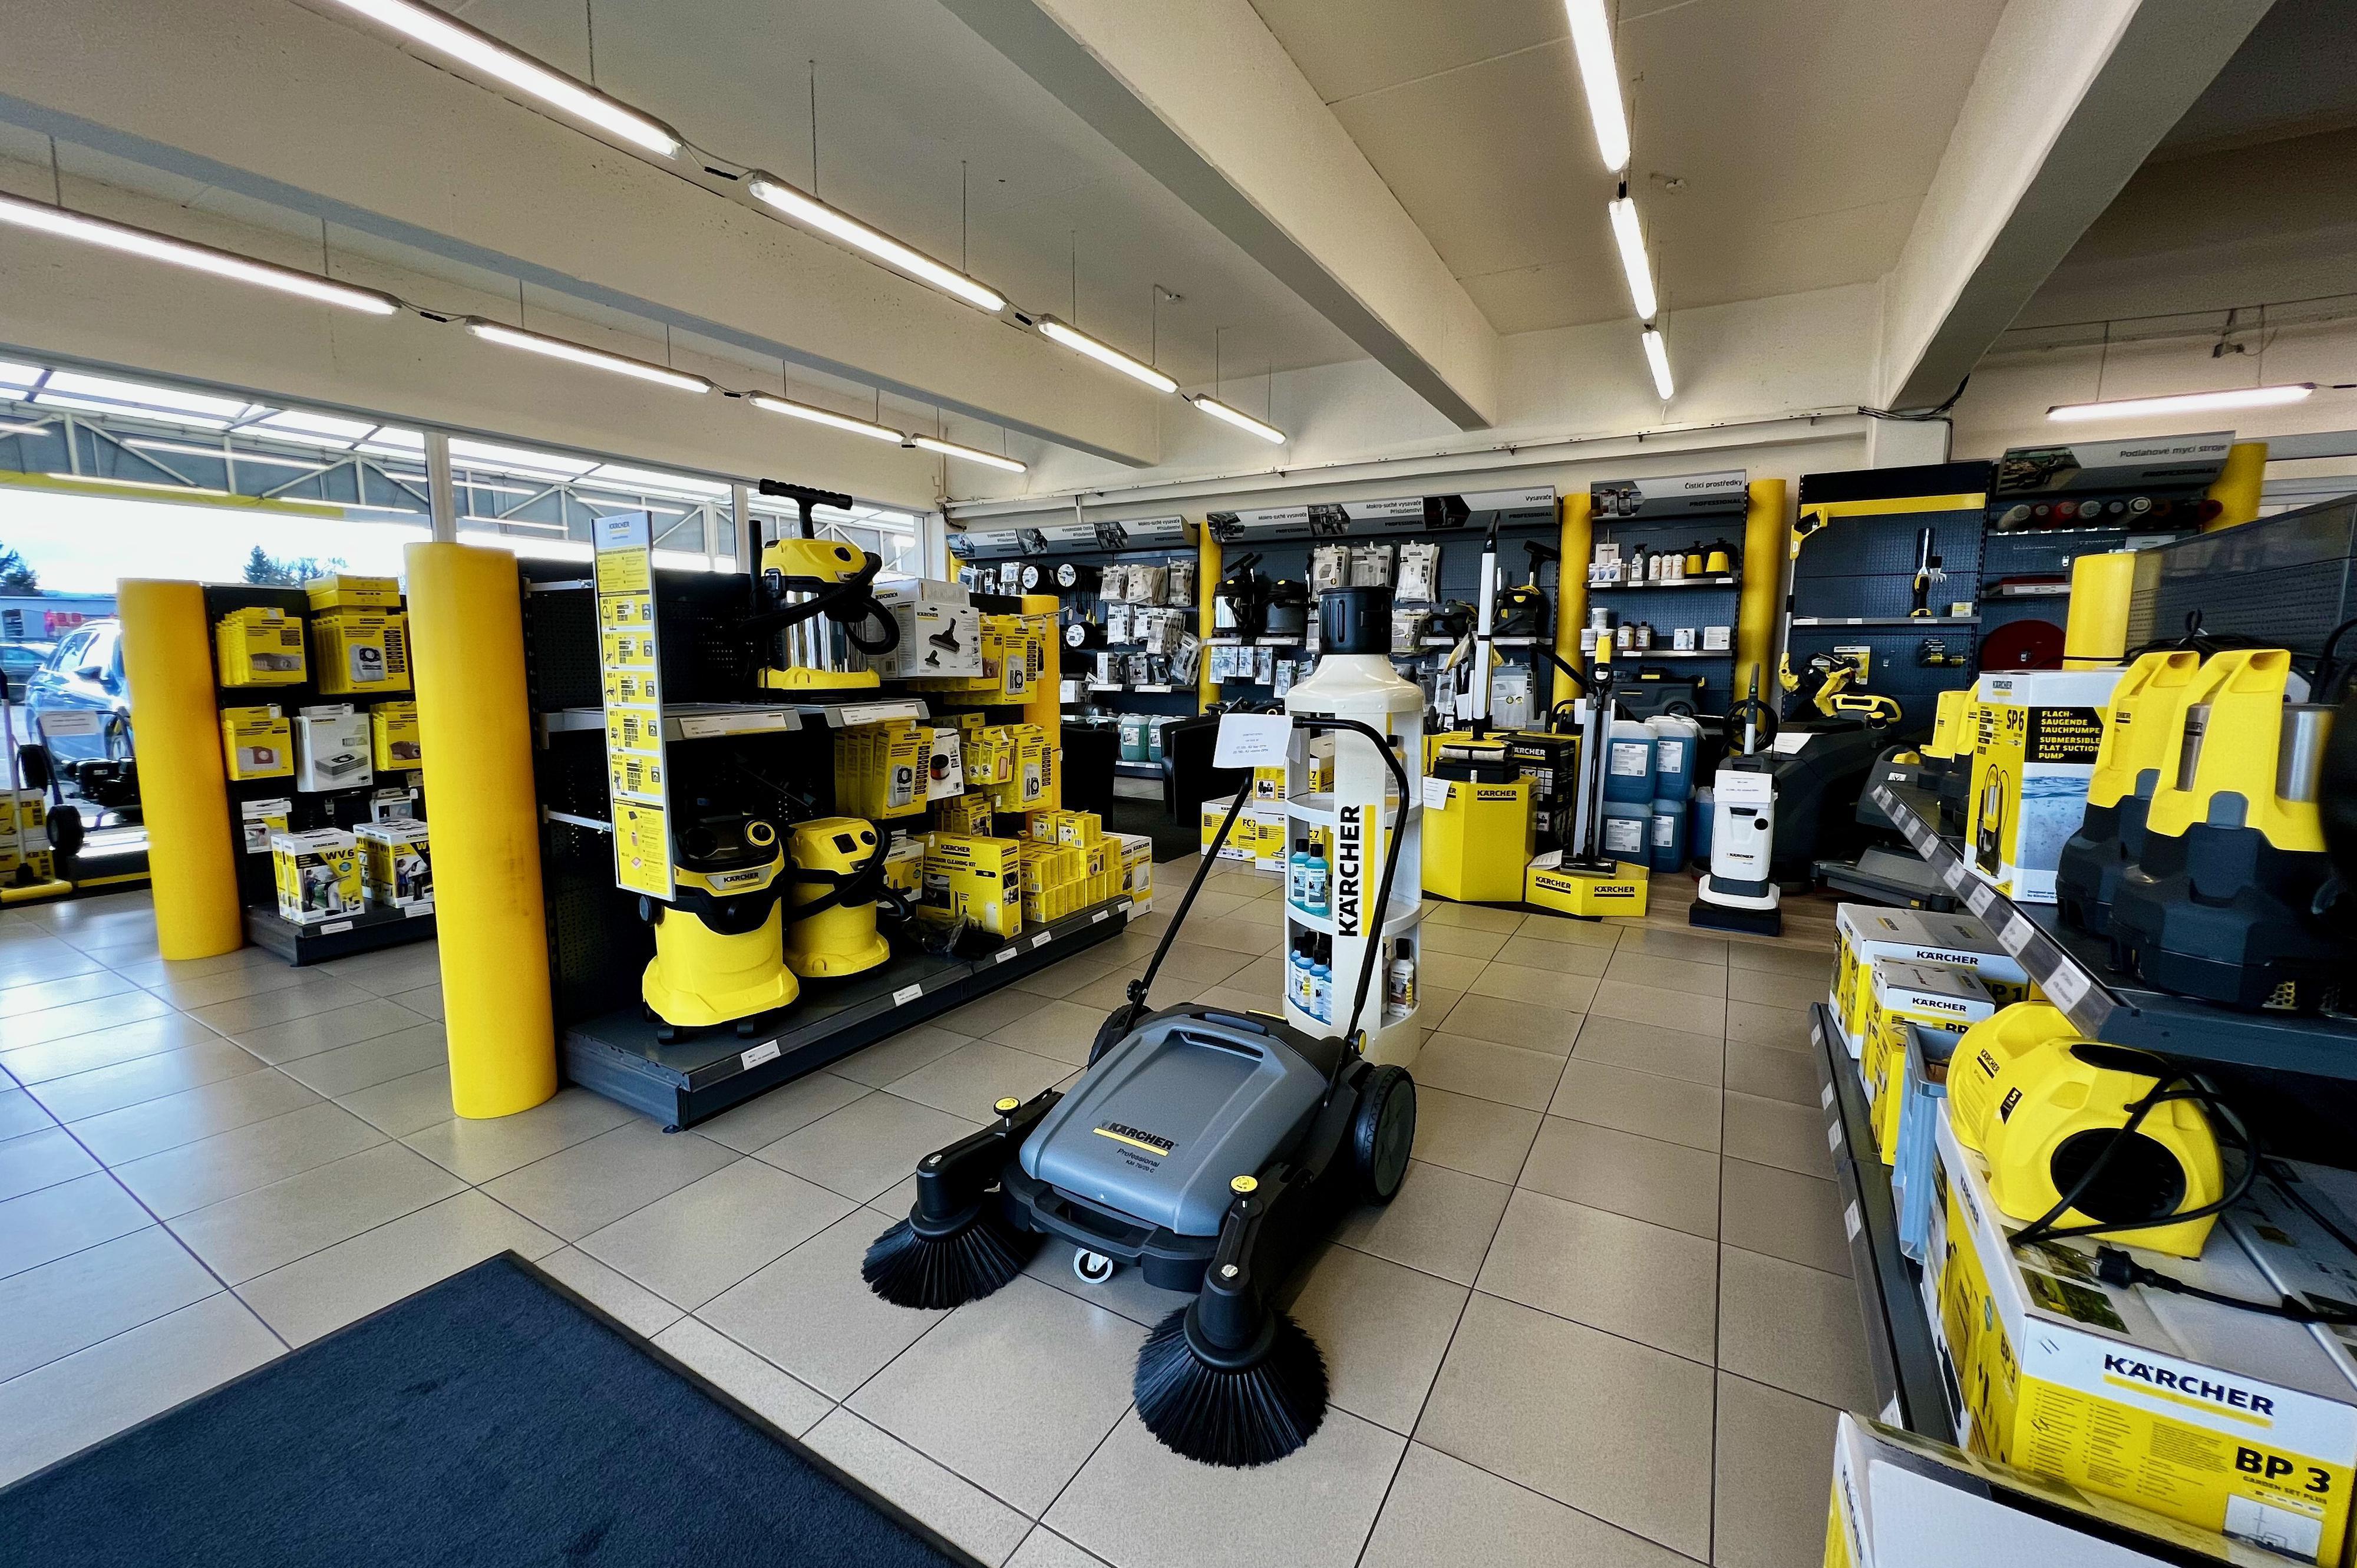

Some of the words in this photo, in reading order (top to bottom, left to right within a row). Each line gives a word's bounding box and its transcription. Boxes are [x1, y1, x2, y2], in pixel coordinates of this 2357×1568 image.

[2120, 447, 2169, 457] Podlahové
[1706, 480, 1743, 488] prostředky
[1689, 499, 1742, 507] PROFESSIONAL
[1992, 681, 2013, 689] KÄRCHER
[1514, 747, 1546, 756] ÄRCHER
[326, 850, 346, 860] WV
[348, 849, 354, 857] 6
[940, 844, 970, 853] KÄRCHER
[724, 872, 759, 883] KÄRCHER
[1338, 804, 1360, 937] KÄRCHER
[1536, 876, 1571, 889] KÄRCHER
[1917, 950, 1979, 965] KÄRCHER
[2012, 986, 2022, 1002] 1
[1912, 997, 1966, 1012] KÄRCHER
[1980, 1048, 2000, 1074] KÄRCHER
[2009, 1090, 2019, 1101] 5
[1108, 1122, 1175, 1150] KÄRCHER
[1117, 1148, 1161, 1167] Professional
[2103, 1353, 2275, 1417] KÄRCHER
[2235, 1446, 2293, 1480] BP
[2305, 1467, 2331, 1493] 3
[2243, 1475, 2282, 1491] GARDEN
[2284, 1487, 2301, 1497] SET
[2303, 1493, 2328, 1505] PLUS
